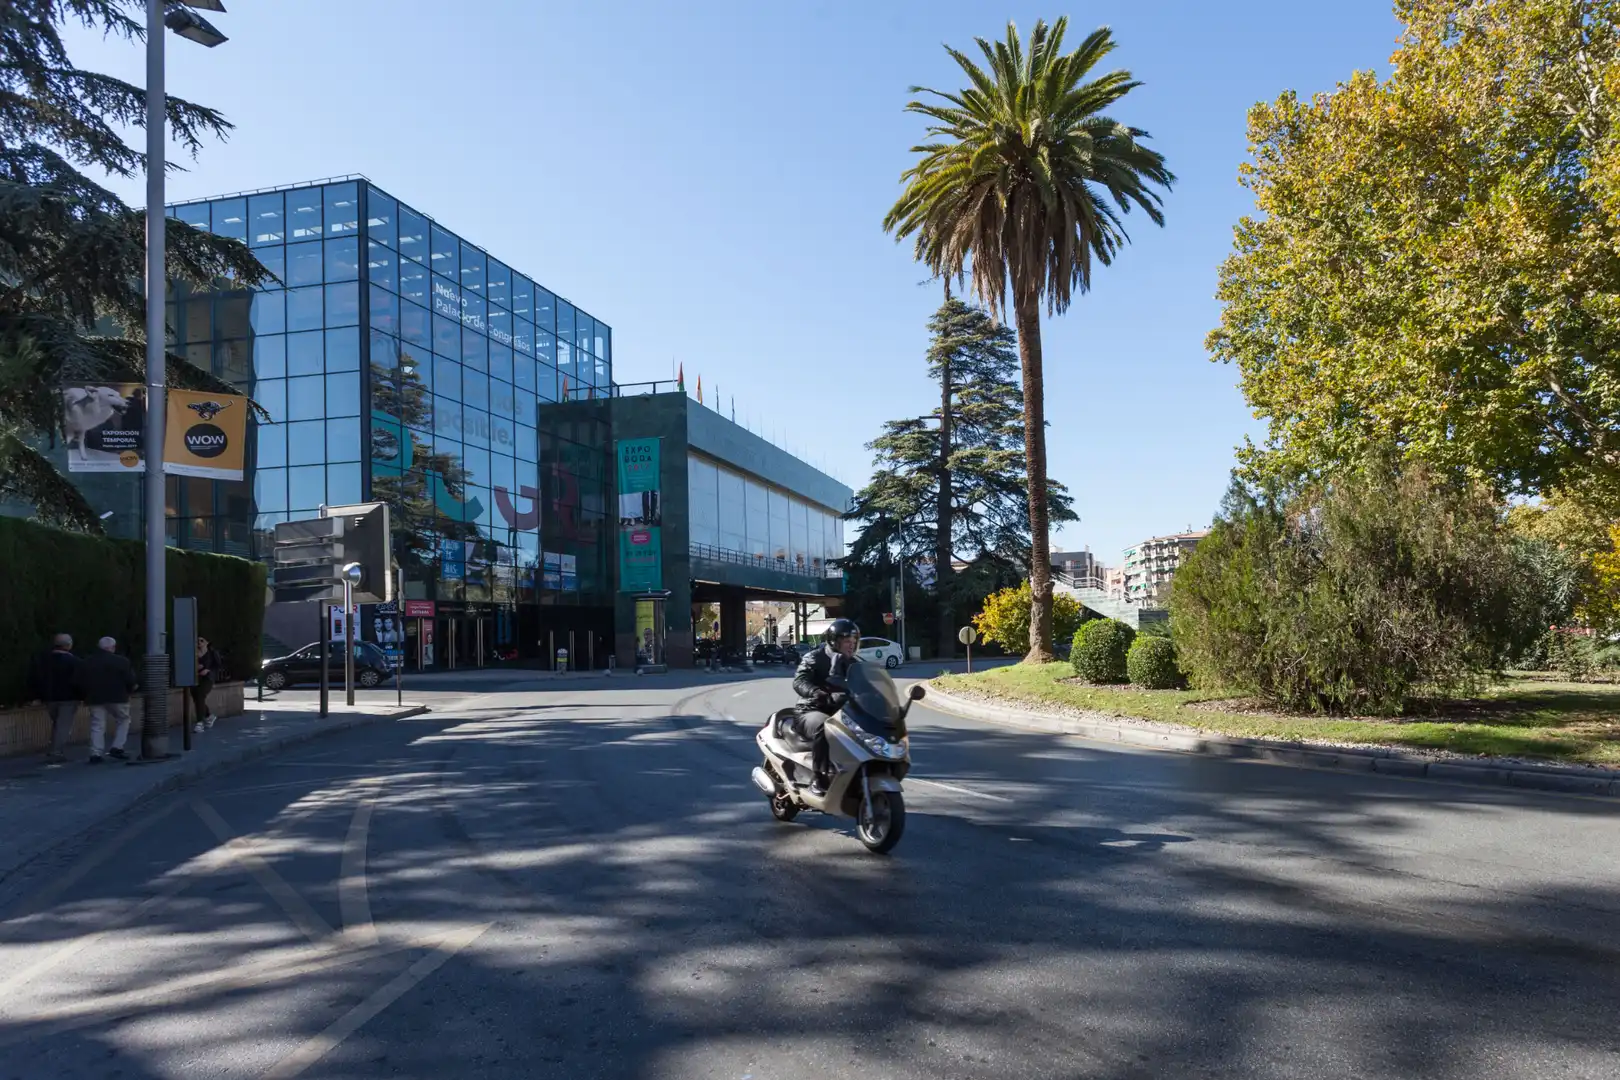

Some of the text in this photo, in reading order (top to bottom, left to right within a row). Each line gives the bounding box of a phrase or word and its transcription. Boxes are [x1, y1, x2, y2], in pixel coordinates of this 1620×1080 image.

[435, 282, 468, 307] Nuevo
[436, 298, 471, 323] Palacio
[473, 316, 485, 330] de
[187, 435, 225, 445] WOW
[625, 446, 651, 455] EXPO
[624, 455, 653, 463] BODA
